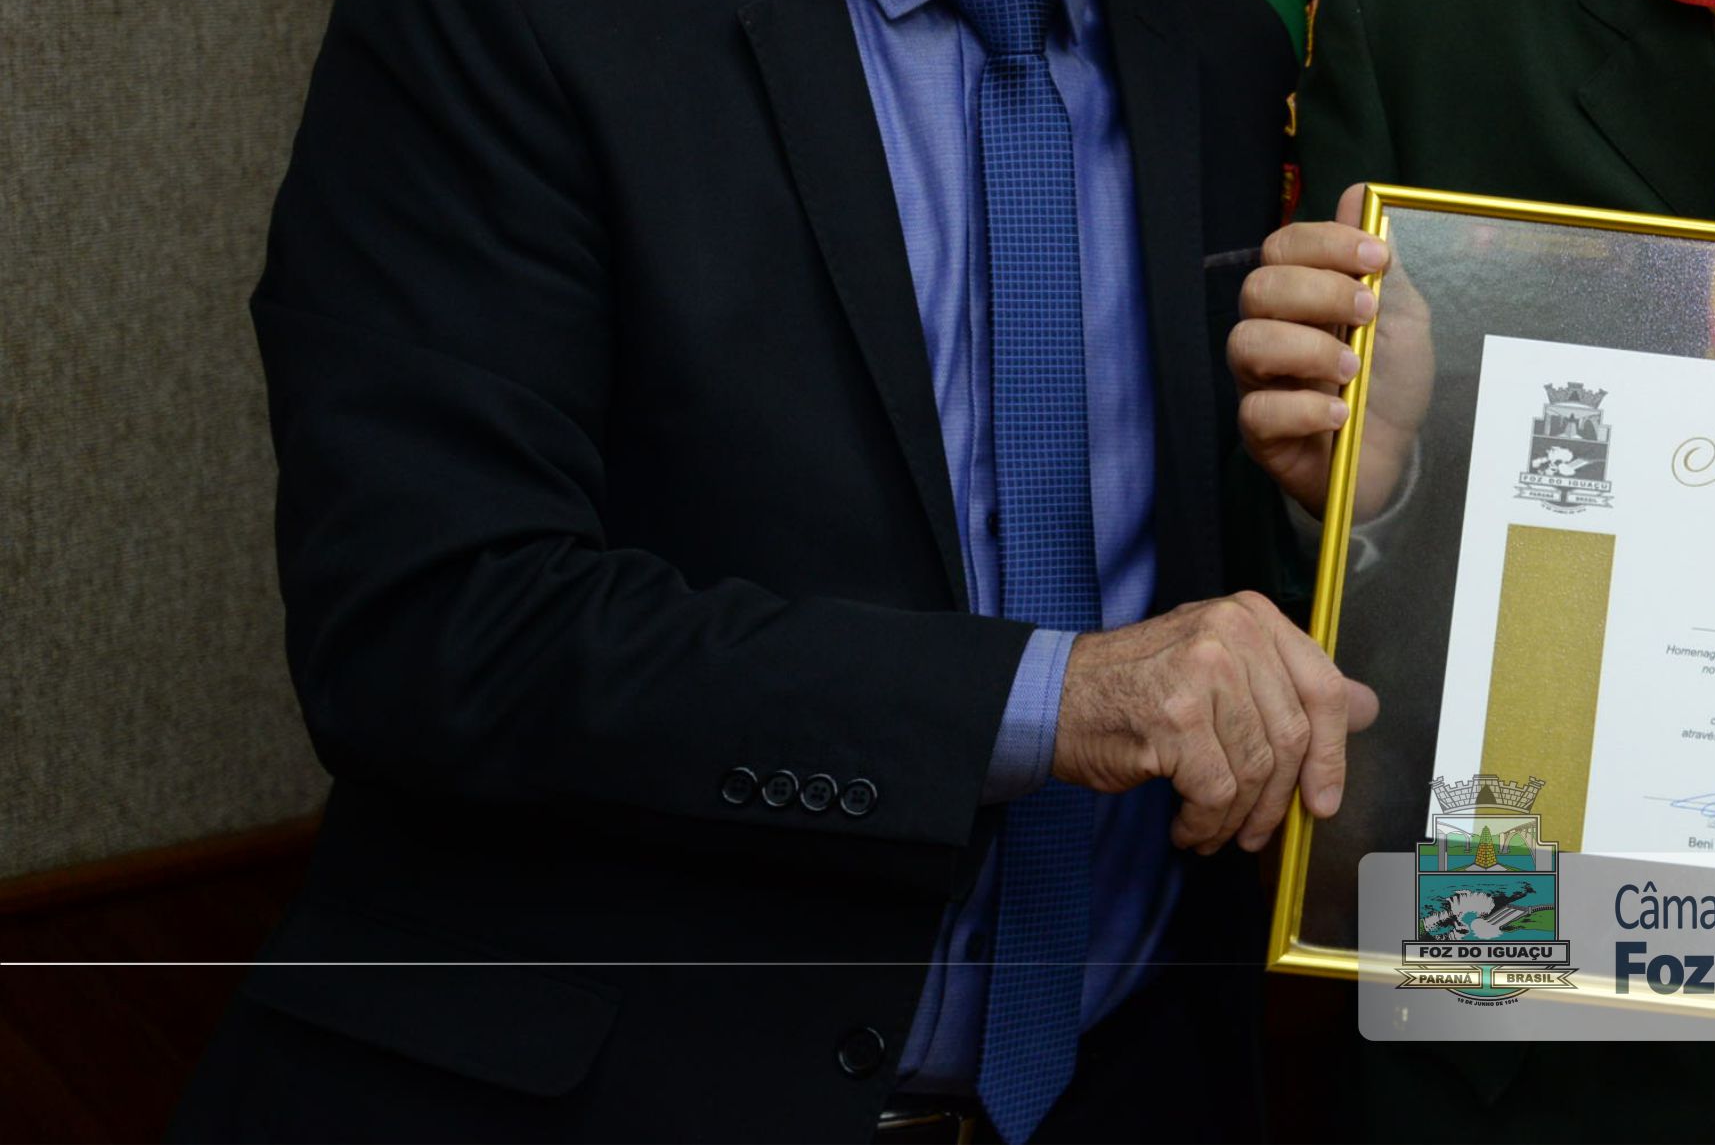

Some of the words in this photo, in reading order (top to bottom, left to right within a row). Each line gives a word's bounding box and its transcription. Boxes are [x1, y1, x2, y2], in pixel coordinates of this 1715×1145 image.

[1523, 475, 1542, 484] FOZ
[1568, 480, 1608, 490] IGUAÇU
[1702, 666, 1715, 675] no
[1688, 837, 1714, 849] Beni
